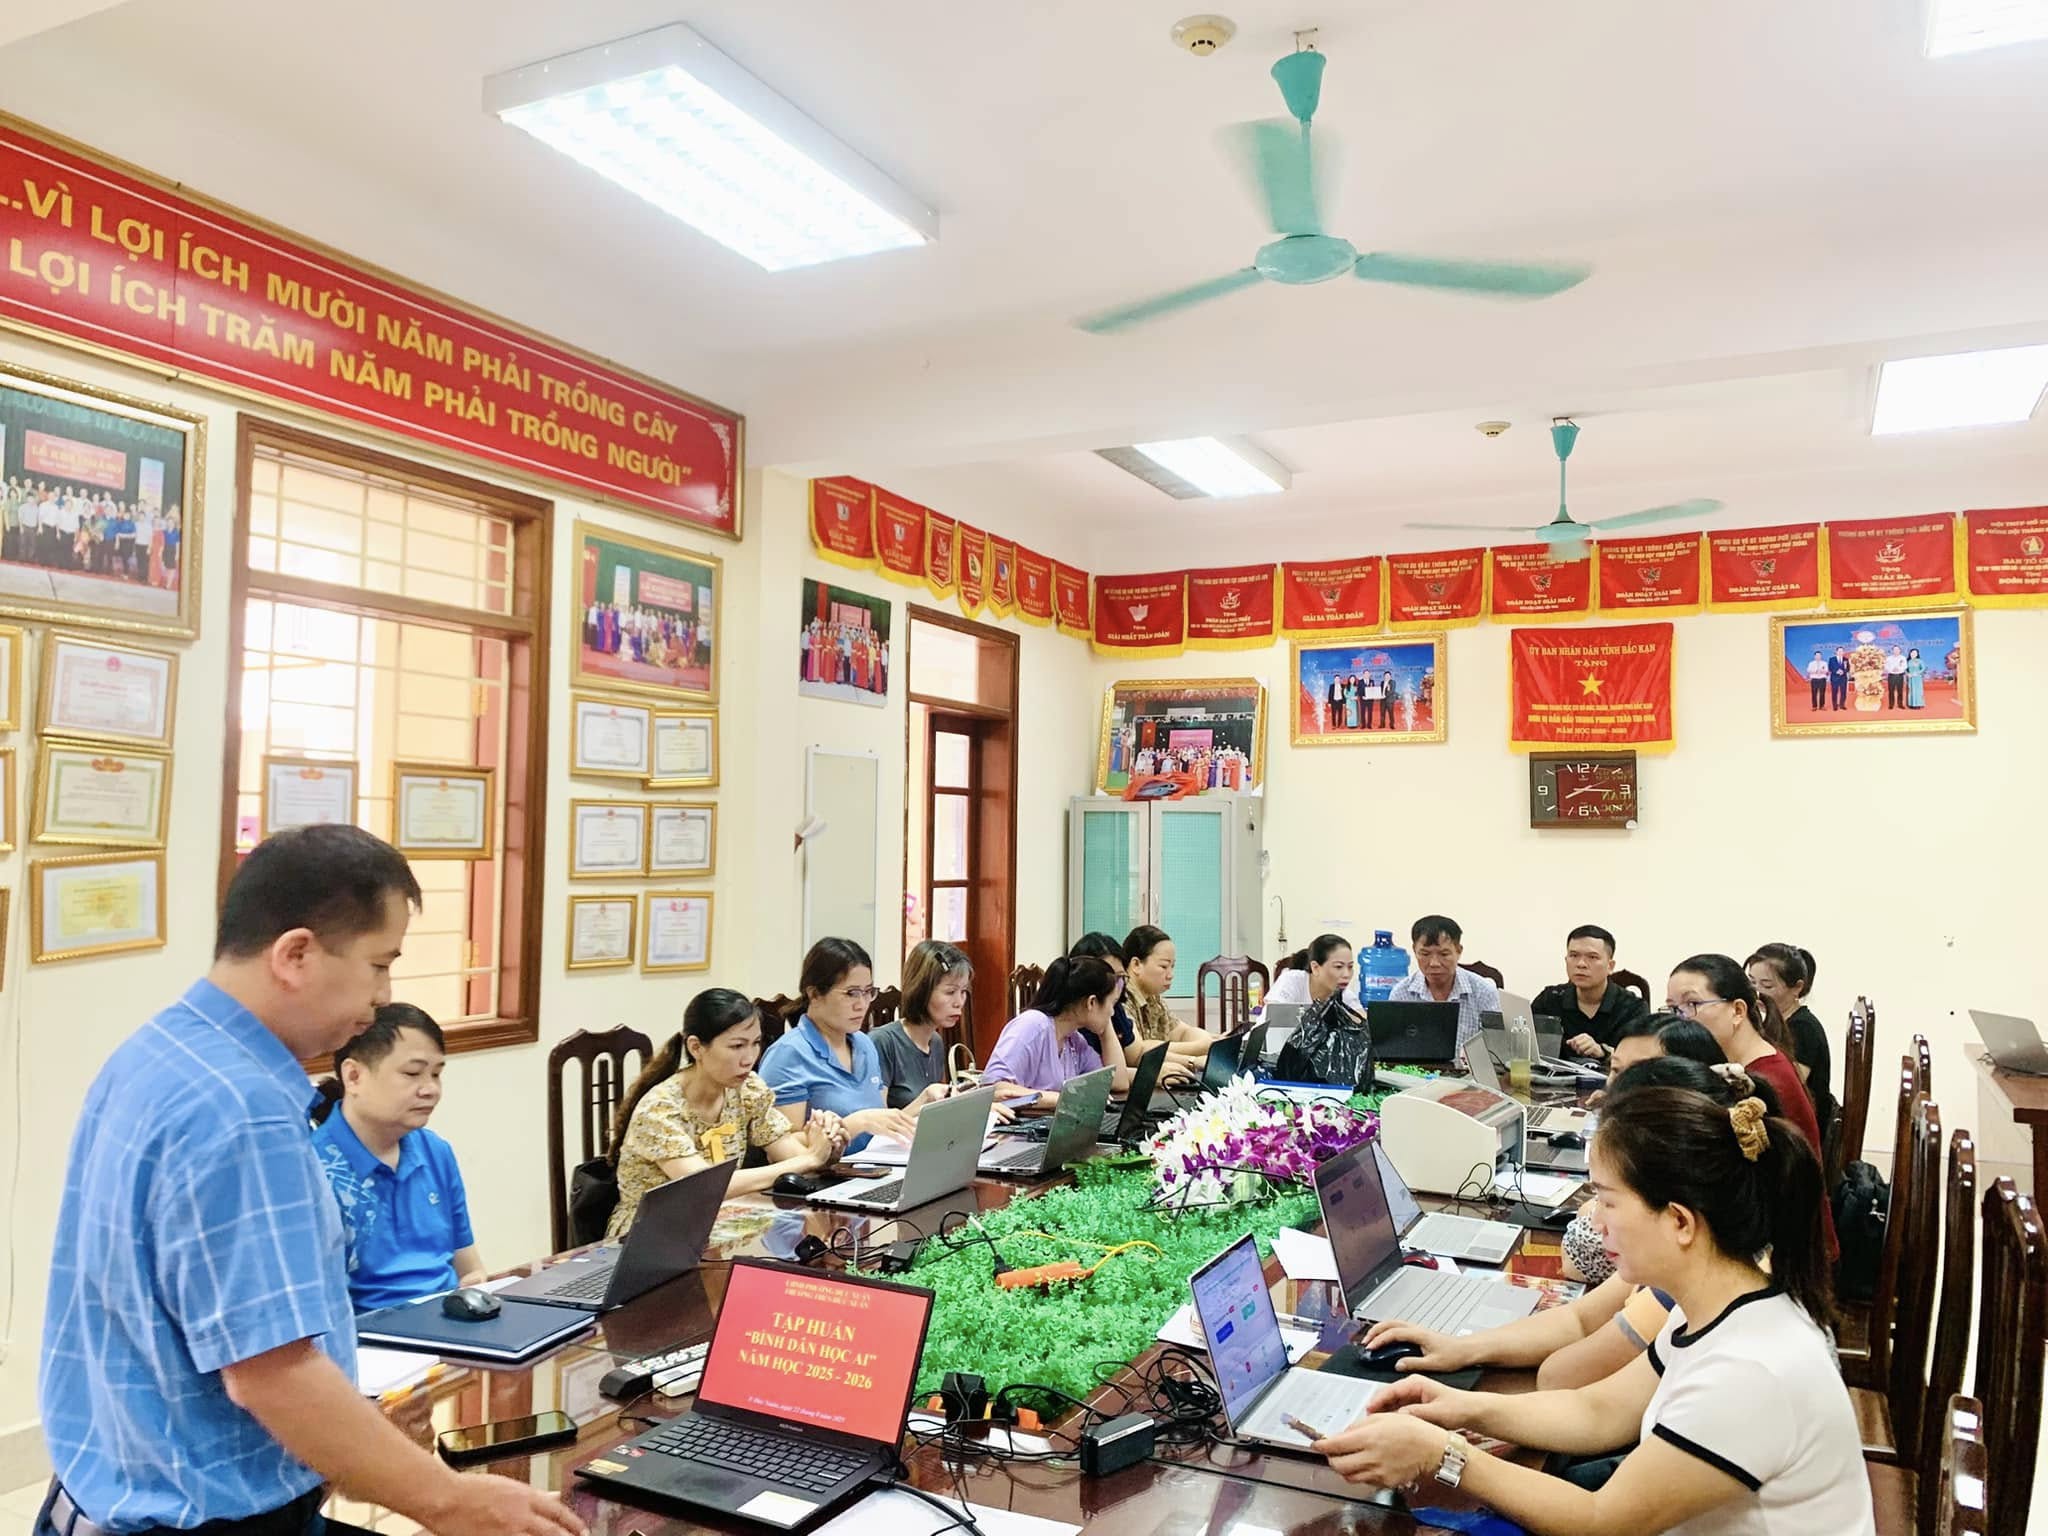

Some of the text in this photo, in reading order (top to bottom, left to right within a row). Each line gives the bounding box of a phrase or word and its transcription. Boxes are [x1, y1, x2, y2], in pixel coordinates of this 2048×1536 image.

[91, 205, 164, 262] LỢI
[179, 231, 249, 293] ÍCH
[267, 272, 366, 335] MƯỜI
[377, 314, 453, 366] NĂM
[463, 347, 531, 393] PHẢI
[537, 373, 626, 427] TRỒNG
[632, 411, 678, 445] CÂY
[9, 237, 90, 296] LỢI
[110, 264, 187, 327] ÍCH
[199, 303, 315, 369] TRĂM
[329, 348, 412, 401] NĂM
[424, 381, 496, 427] PHẢI
[506, 408, 600, 460] TRỒNG
[1541, 646, 1557, 656] BAN
[1559, 644, 1581, 656] NHÂN
[1582, 644, 1599, 656] DÂN
[1621, 640, 1638, 655] BẮC
[1638, 643, 1656, 654] KẠN
[1577, 763, 1590, 774] 12
[1537, 785, 1548, 796] 9
[1619, 784, 1630, 795] 3
[1579, 806, 1589, 816] 6
[773, 1311, 857, 1342] TẬP HUẤN
[788, 1337, 817, 1355] DÂN
[819, 1344, 851, 1363] HỌC
[737, 1348, 770, 1367] NĂM
[772, 1356, 803, 1375] HỌC
[805, 1363, 833, 1381] 2025
[844, 1372, 872, 1389] 2026
